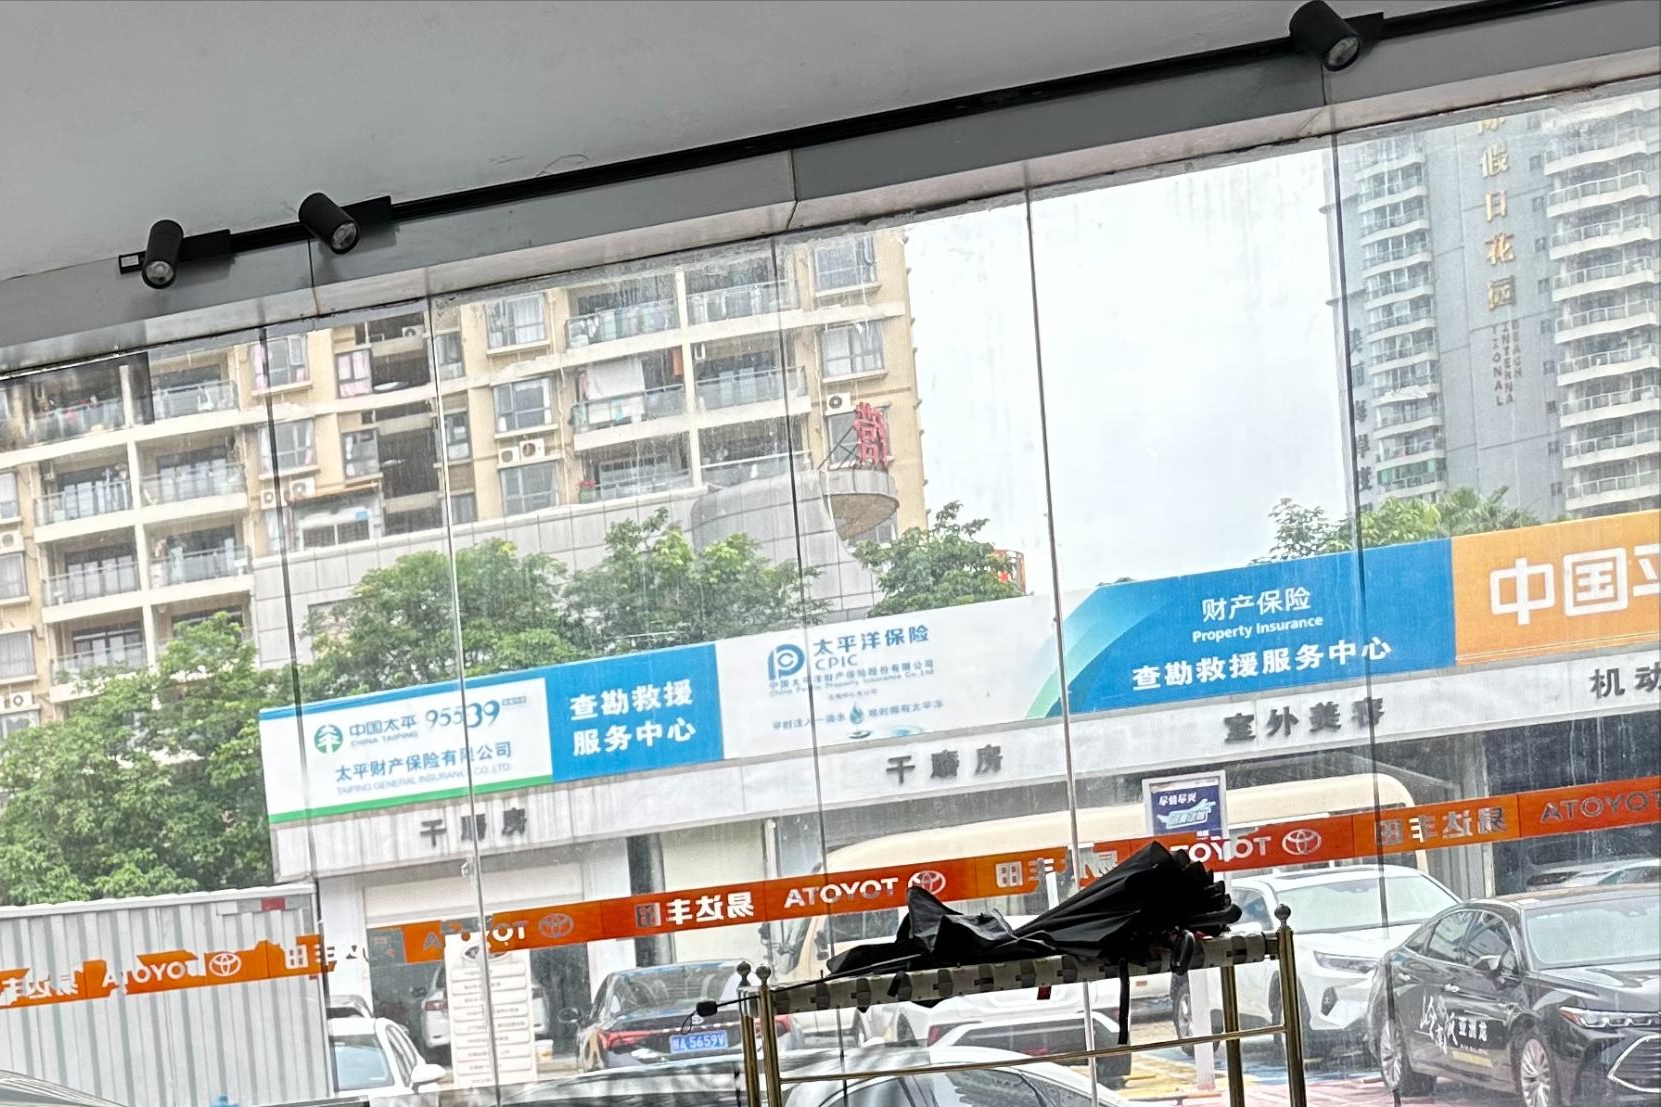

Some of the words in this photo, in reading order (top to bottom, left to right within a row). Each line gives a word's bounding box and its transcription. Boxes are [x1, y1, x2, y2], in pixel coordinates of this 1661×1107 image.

[1201, 585, 1312, 623] 财产保险
[813, 624, 929, 655] 太平洋保险
[1192, 624, 1252, 643] Property
[1255, 615, 1324, 635] Insurance
[815, 654, 859, 671] CPIC
[1132, 636, 1393, 691] 查勘救援服务中心
[569, 677, 693, 721] 查勘救援
[348, 714, 418, 738] 中国太平
[424, 699, 502, 731] 95539
[573, 717, 697, 757] 服务中心
[350, 737, 379, 748] CHINA
[382, 730, 419, 744] TAIPING
[335, 740, 512, 784] 太平财产保险有限公司
[419, 769, 469, 784] INSURANC
